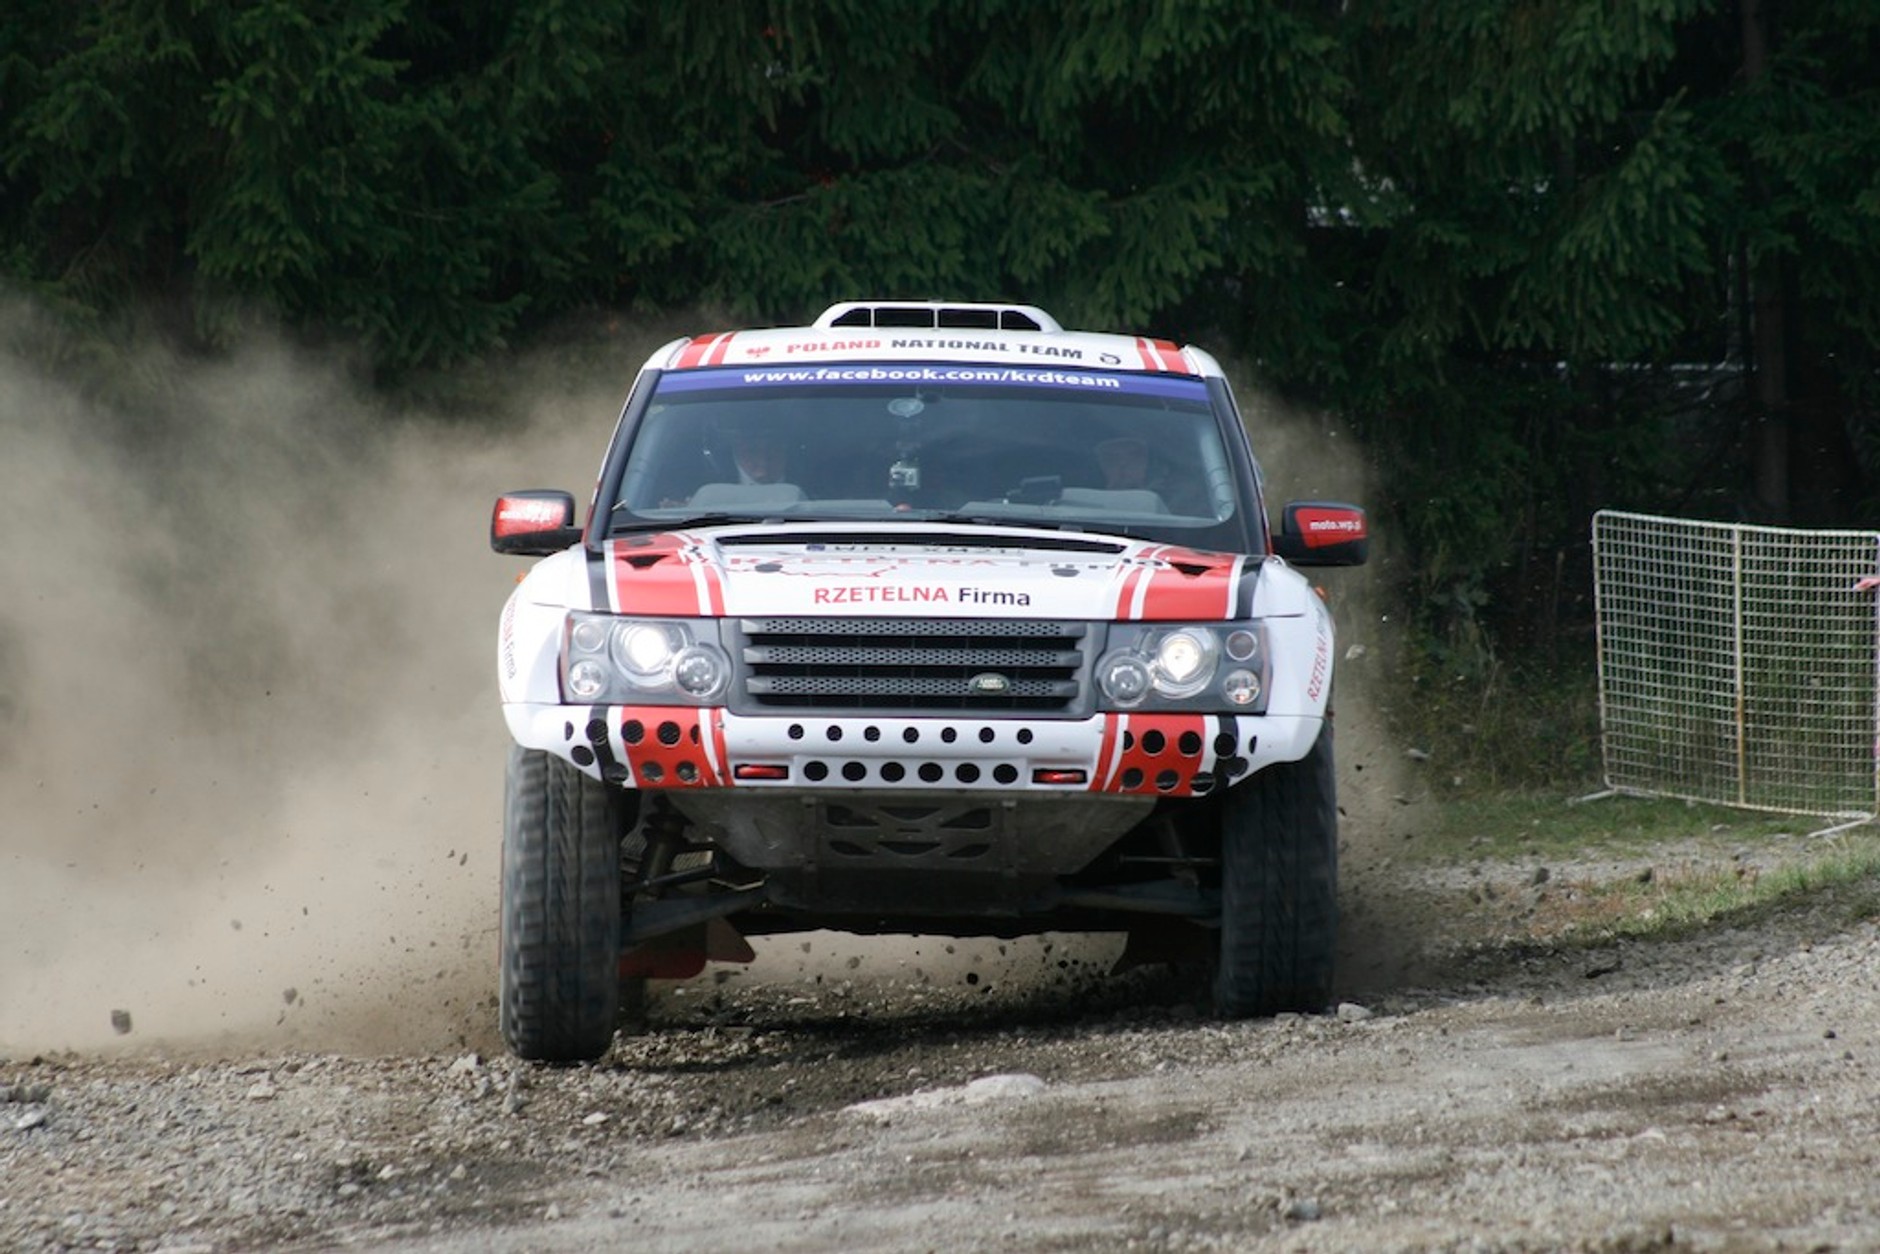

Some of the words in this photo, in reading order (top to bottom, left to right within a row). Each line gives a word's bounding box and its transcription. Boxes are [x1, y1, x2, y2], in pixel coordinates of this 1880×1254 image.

[787, 340, 881, 354] POLAND
[891, 339, 1010, 351] NATIONAL
[1017, 343, 1083, 359] TEAM
[743, 368, 1121, 388] www.facebook.com/krdteam
[814, 586, 949, 604] RZETELNA
[958, 587, 1031, 606] Firma
